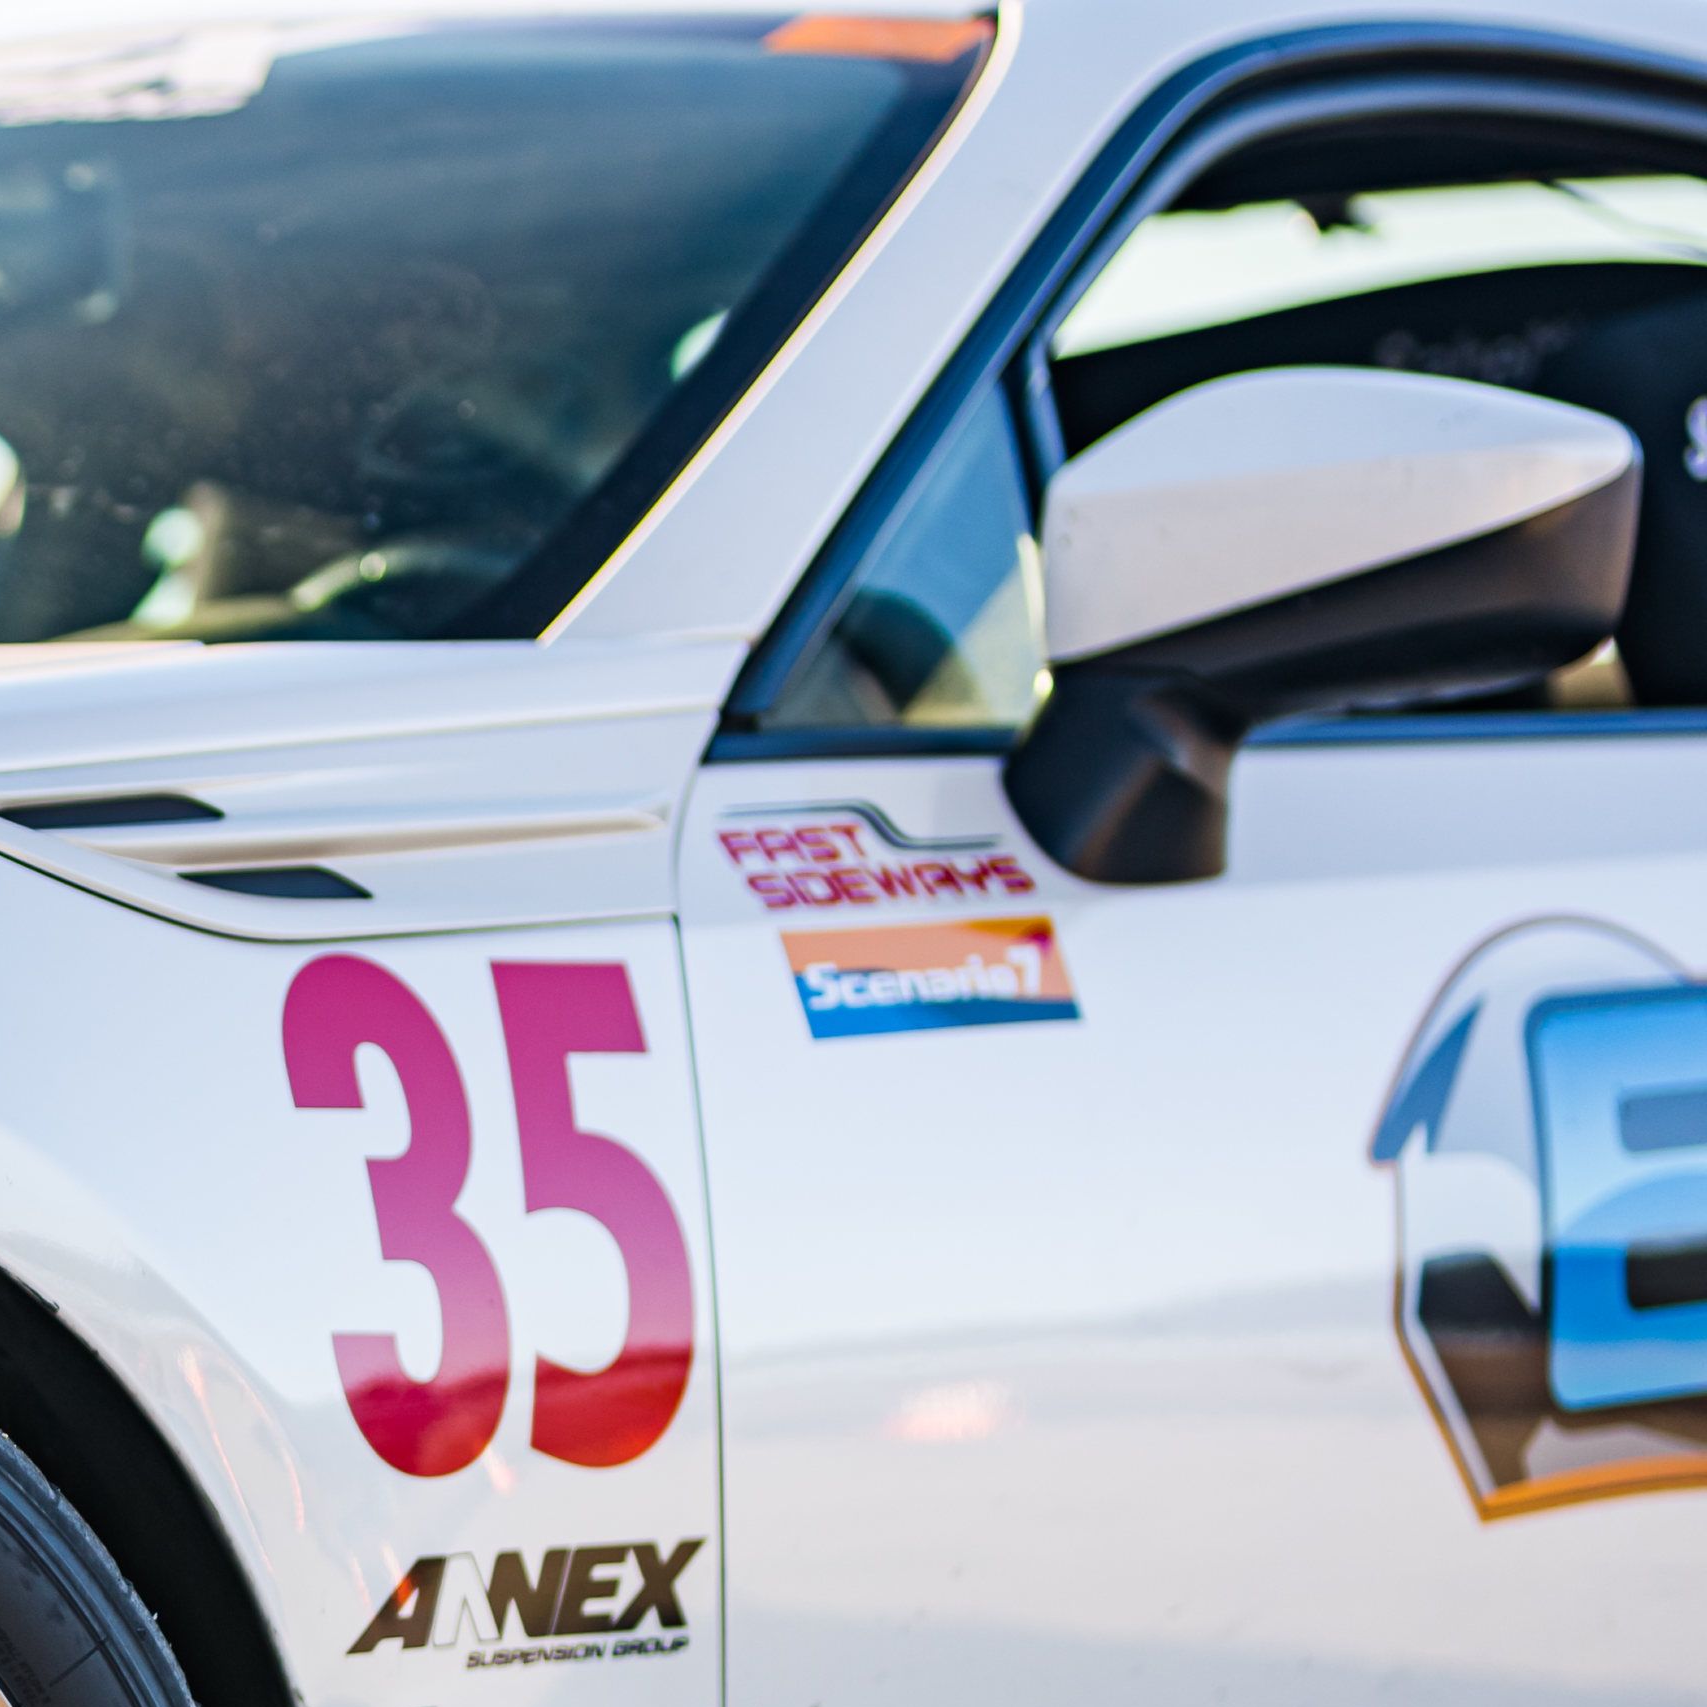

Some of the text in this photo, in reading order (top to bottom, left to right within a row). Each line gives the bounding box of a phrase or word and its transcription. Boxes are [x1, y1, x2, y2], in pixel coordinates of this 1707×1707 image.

[717, 824, 868, 865] FAST
[747, 855, 1036, 911] SIDEWAYS
[804, 944, 1043, 1011] Scenario7
[282, 950, 695, 1478] 35
[466, 1637, 690, 1668] SUSPENSION GROUP
